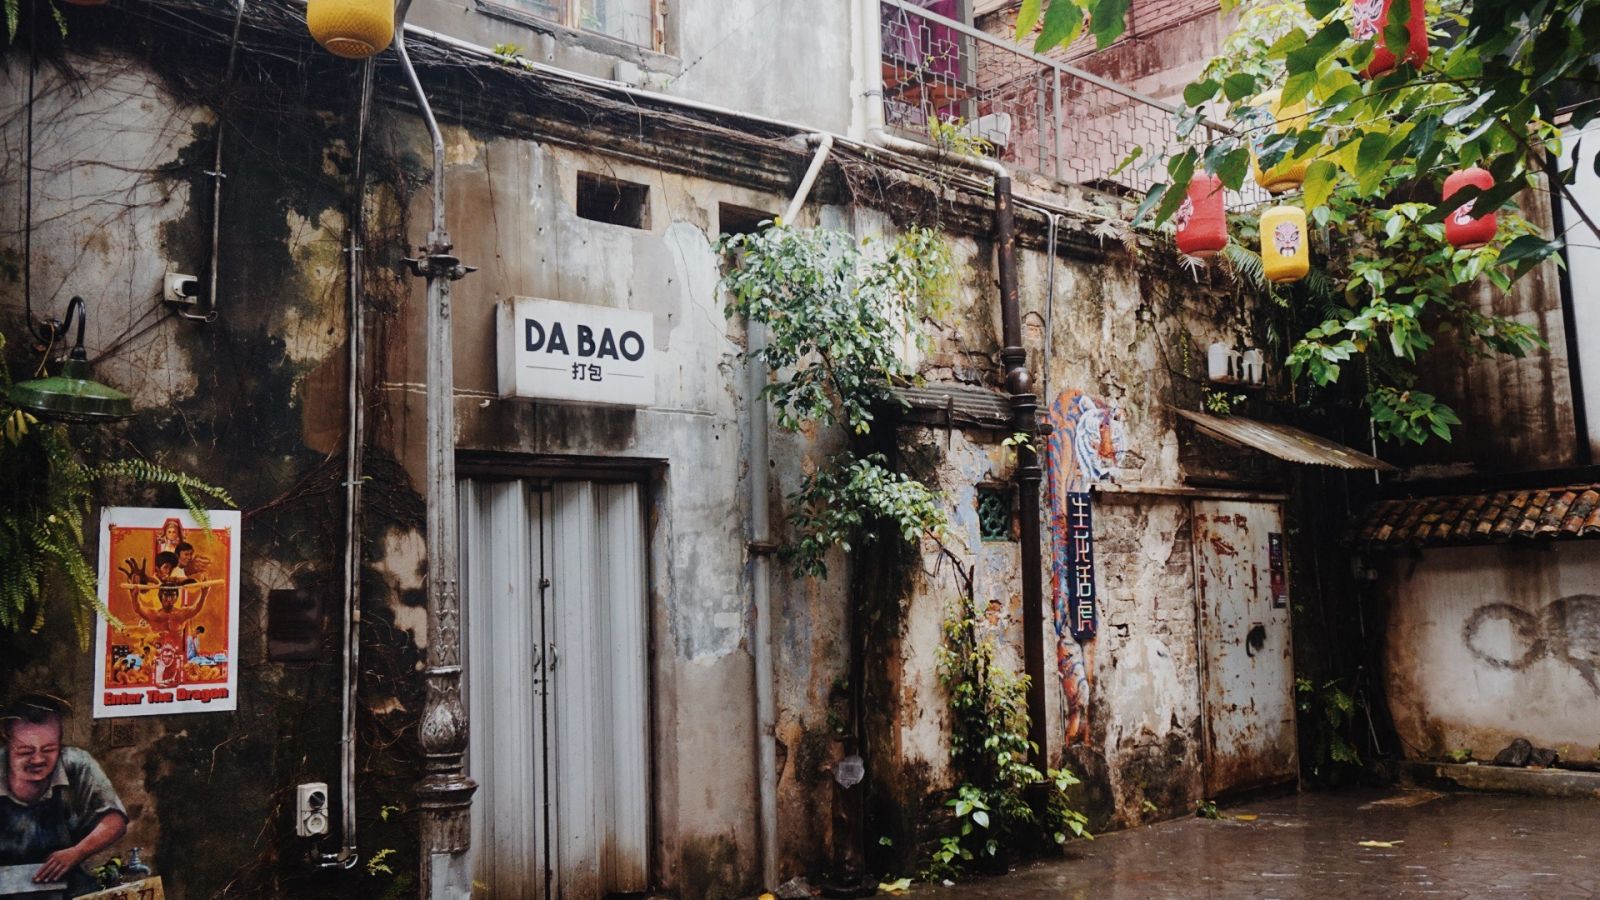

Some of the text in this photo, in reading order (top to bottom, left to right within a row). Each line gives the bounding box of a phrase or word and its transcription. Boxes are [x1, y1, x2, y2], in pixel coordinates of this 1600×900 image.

[525, 318, 645, 362] DA BAO
[571, 361, 603, 382] 打包
[103, 687, 229, 706] Enter The Dragon
